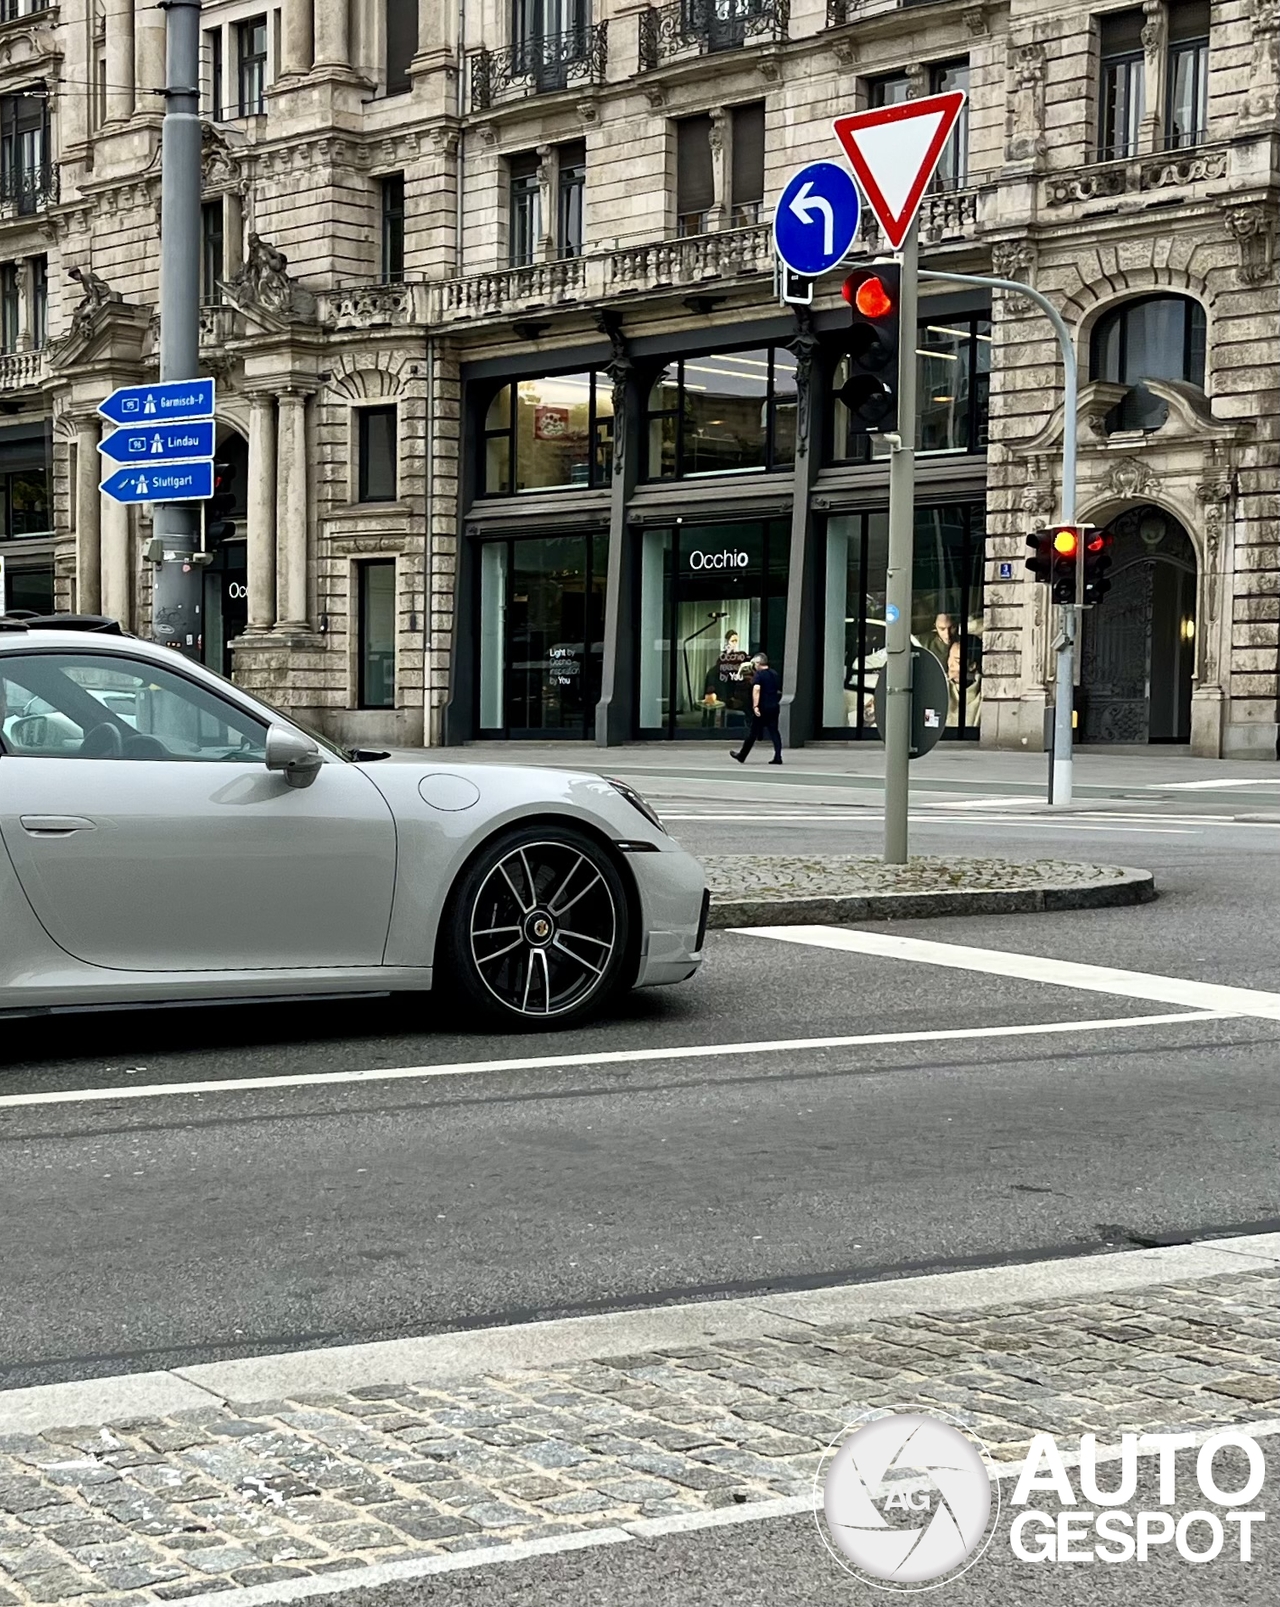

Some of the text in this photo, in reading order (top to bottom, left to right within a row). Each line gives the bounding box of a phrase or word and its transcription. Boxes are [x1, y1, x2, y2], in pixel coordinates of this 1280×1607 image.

[126, 401, 135, 410] 95
[133, 435, 199, 450] 96 Lindau
[152, 475, 193, 489] Stuttgart
[689, 548, 749, 570] Occhio
[557, 675, 570, 684] You
